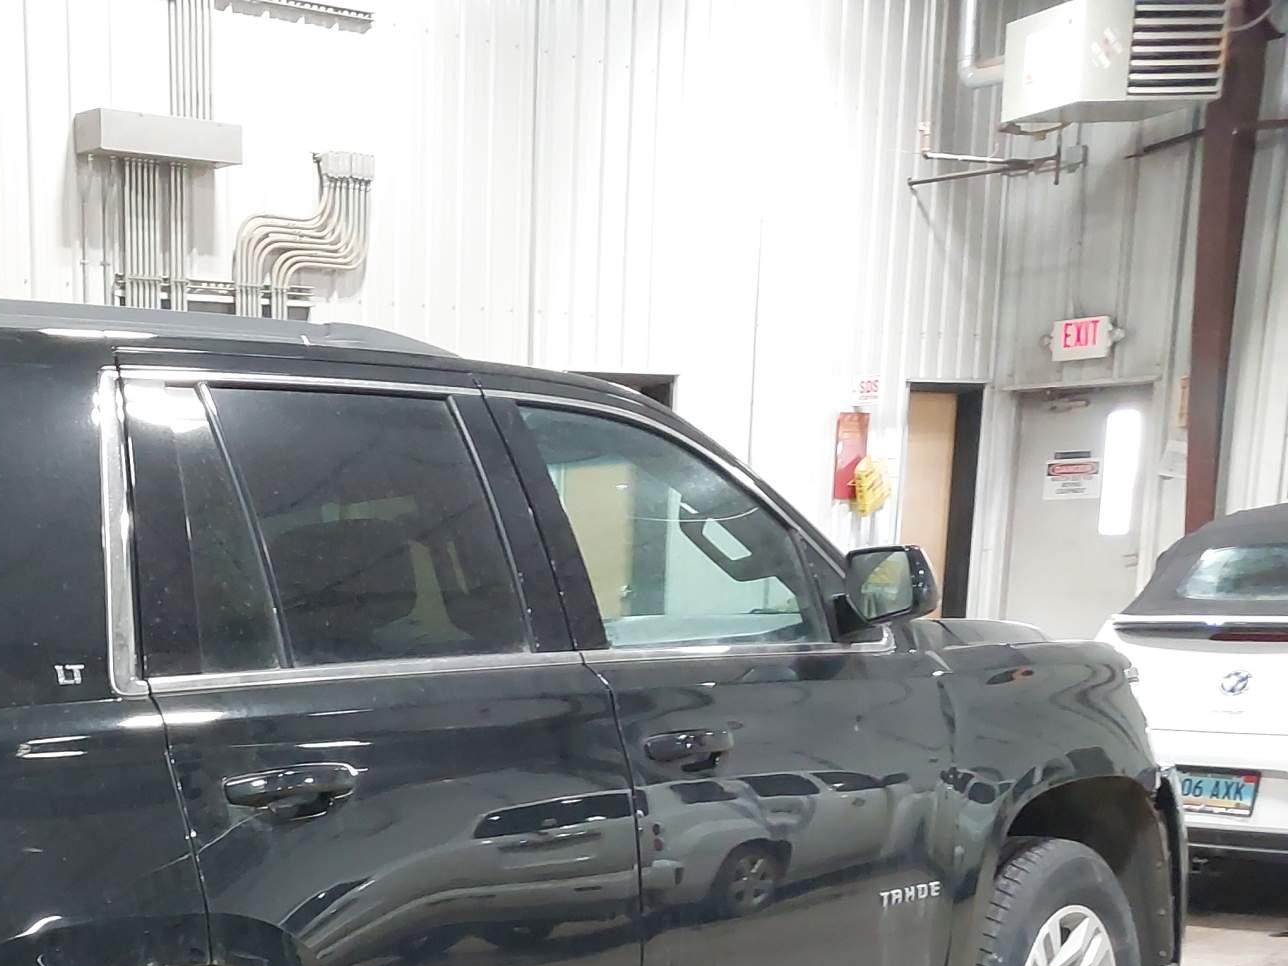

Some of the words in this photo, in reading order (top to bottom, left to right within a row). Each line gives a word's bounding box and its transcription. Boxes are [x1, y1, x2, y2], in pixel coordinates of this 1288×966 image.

[1063, 320, 1099, 348] EXIT
[54, 664, 85, 685] LT
[1210, 780, 1245, 801] AXK
[879, 881, 941, 908] TAHOE
